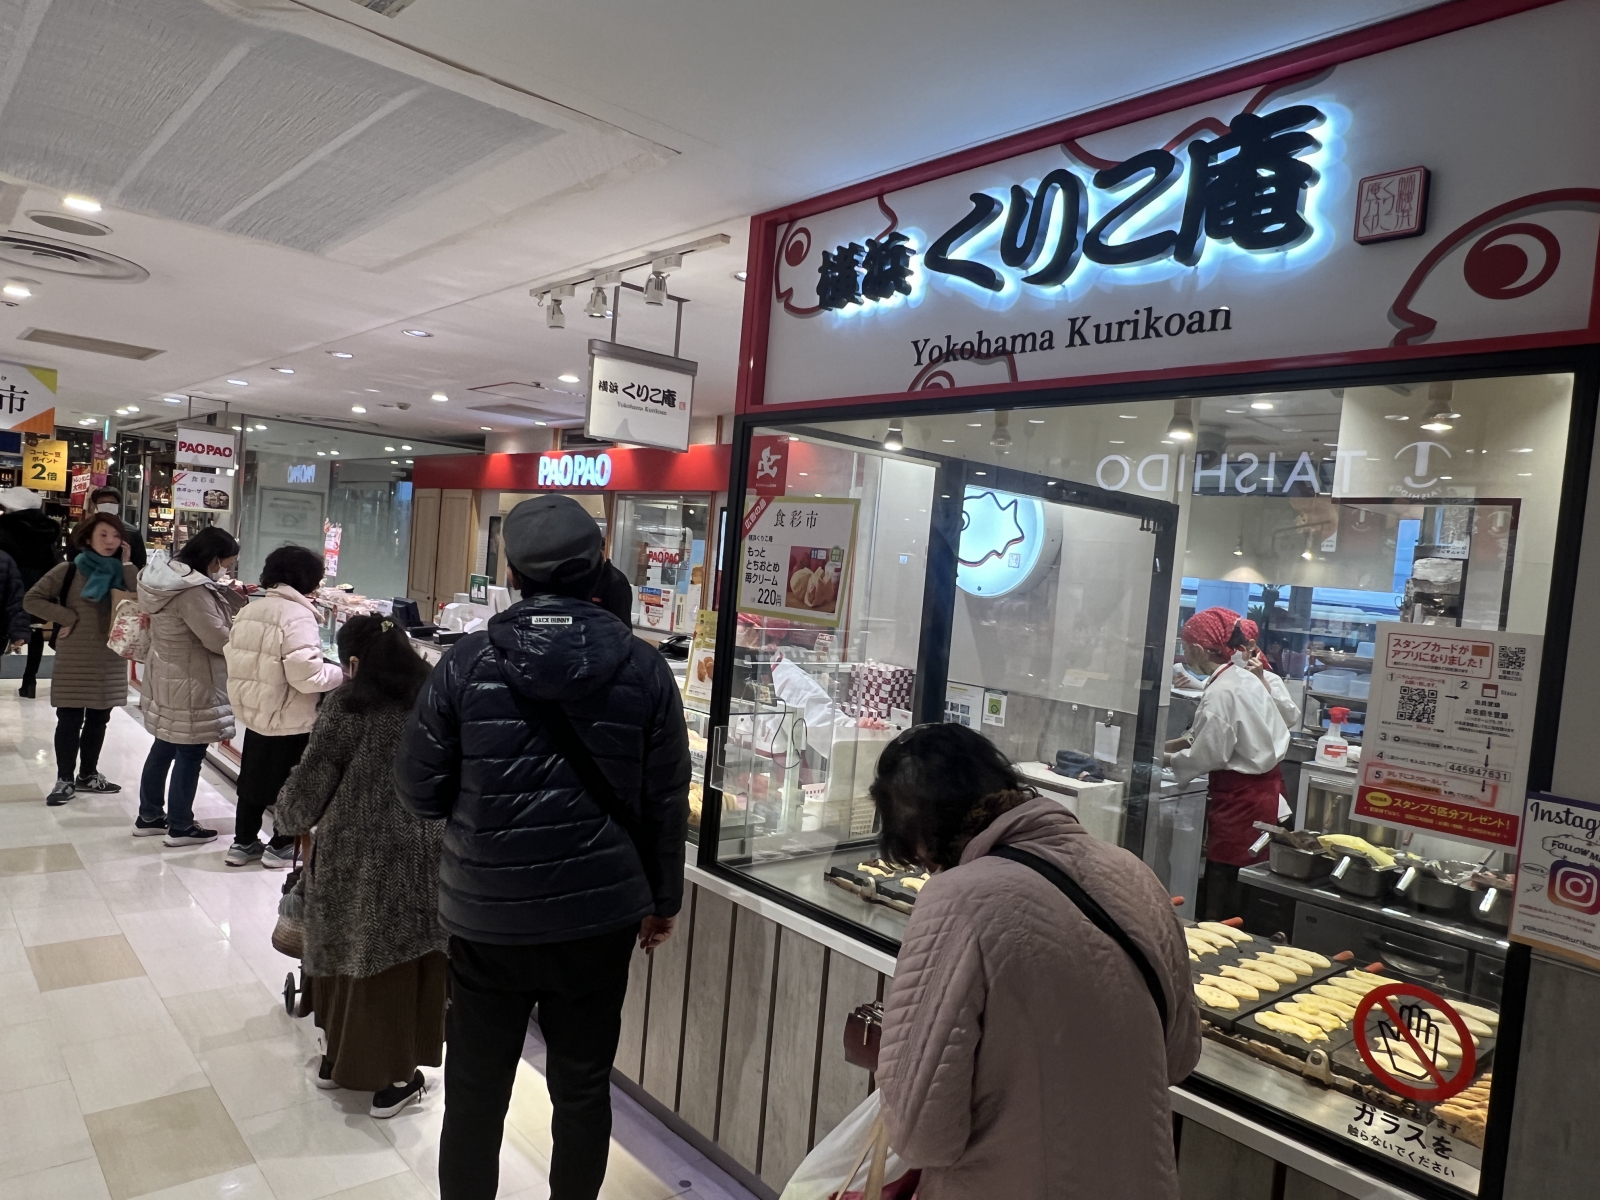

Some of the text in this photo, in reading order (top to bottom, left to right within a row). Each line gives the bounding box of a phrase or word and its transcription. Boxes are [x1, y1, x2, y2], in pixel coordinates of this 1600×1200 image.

[816, 104, 1328, 311] 横浜 くりこ庵
[911, 304, 1232, 367] Yokohama Kurikoan
[598, 379, 677, 408] 横浜 くりこ庵
[538, 453, 612, 487] PAOPAO
[773, 508, 819, 529] 食彩市
[747, 546, 766, 558] もっと
[746, 559, 780, 573] とちおとめ
[745, 572, 778, 586] 苺クリーム
[757, 588, 777, 606] 220
[1392, 638, 1470, 655] スタンプカードが
[1551, 839, 1590, 857] FOLLOW
[1353, 1103, 1453, 1160] ガラスを
[1347, 1123, 1456, 1178] 触らないでください
